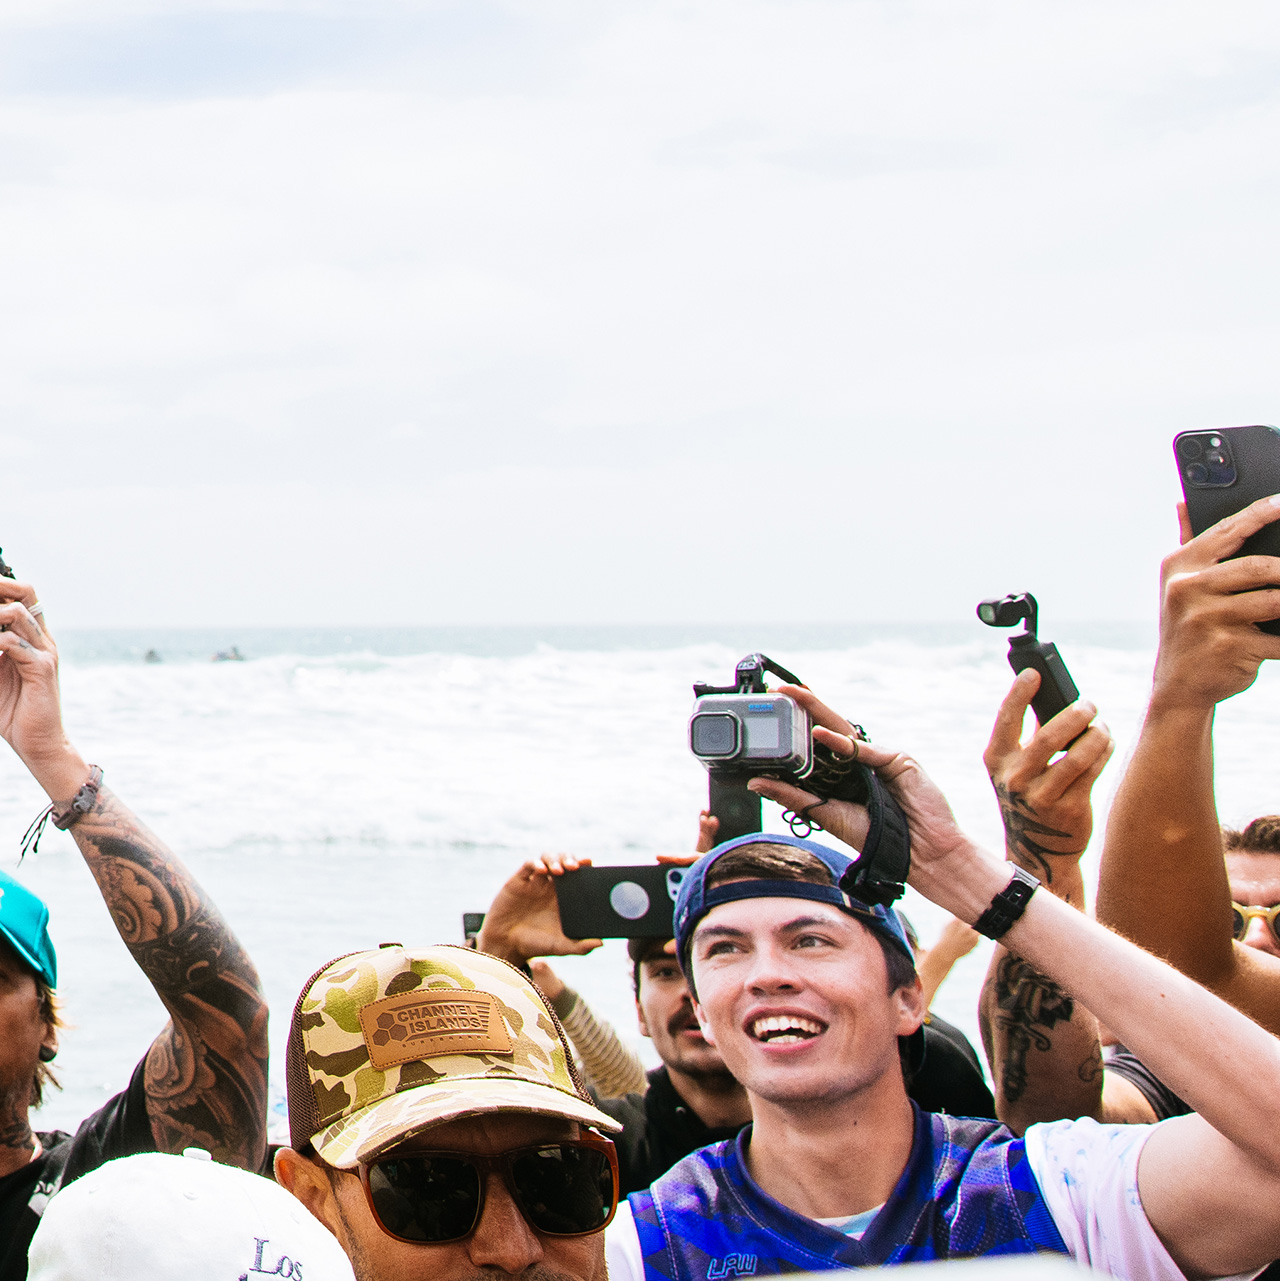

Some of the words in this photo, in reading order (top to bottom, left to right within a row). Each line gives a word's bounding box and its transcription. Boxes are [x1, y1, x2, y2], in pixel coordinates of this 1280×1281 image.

[396, 1004, 479, 1023] CHANNEL
[409, 1016, 482, 1034] ISLANDS
[249, 1237, 303, 1281] Los
